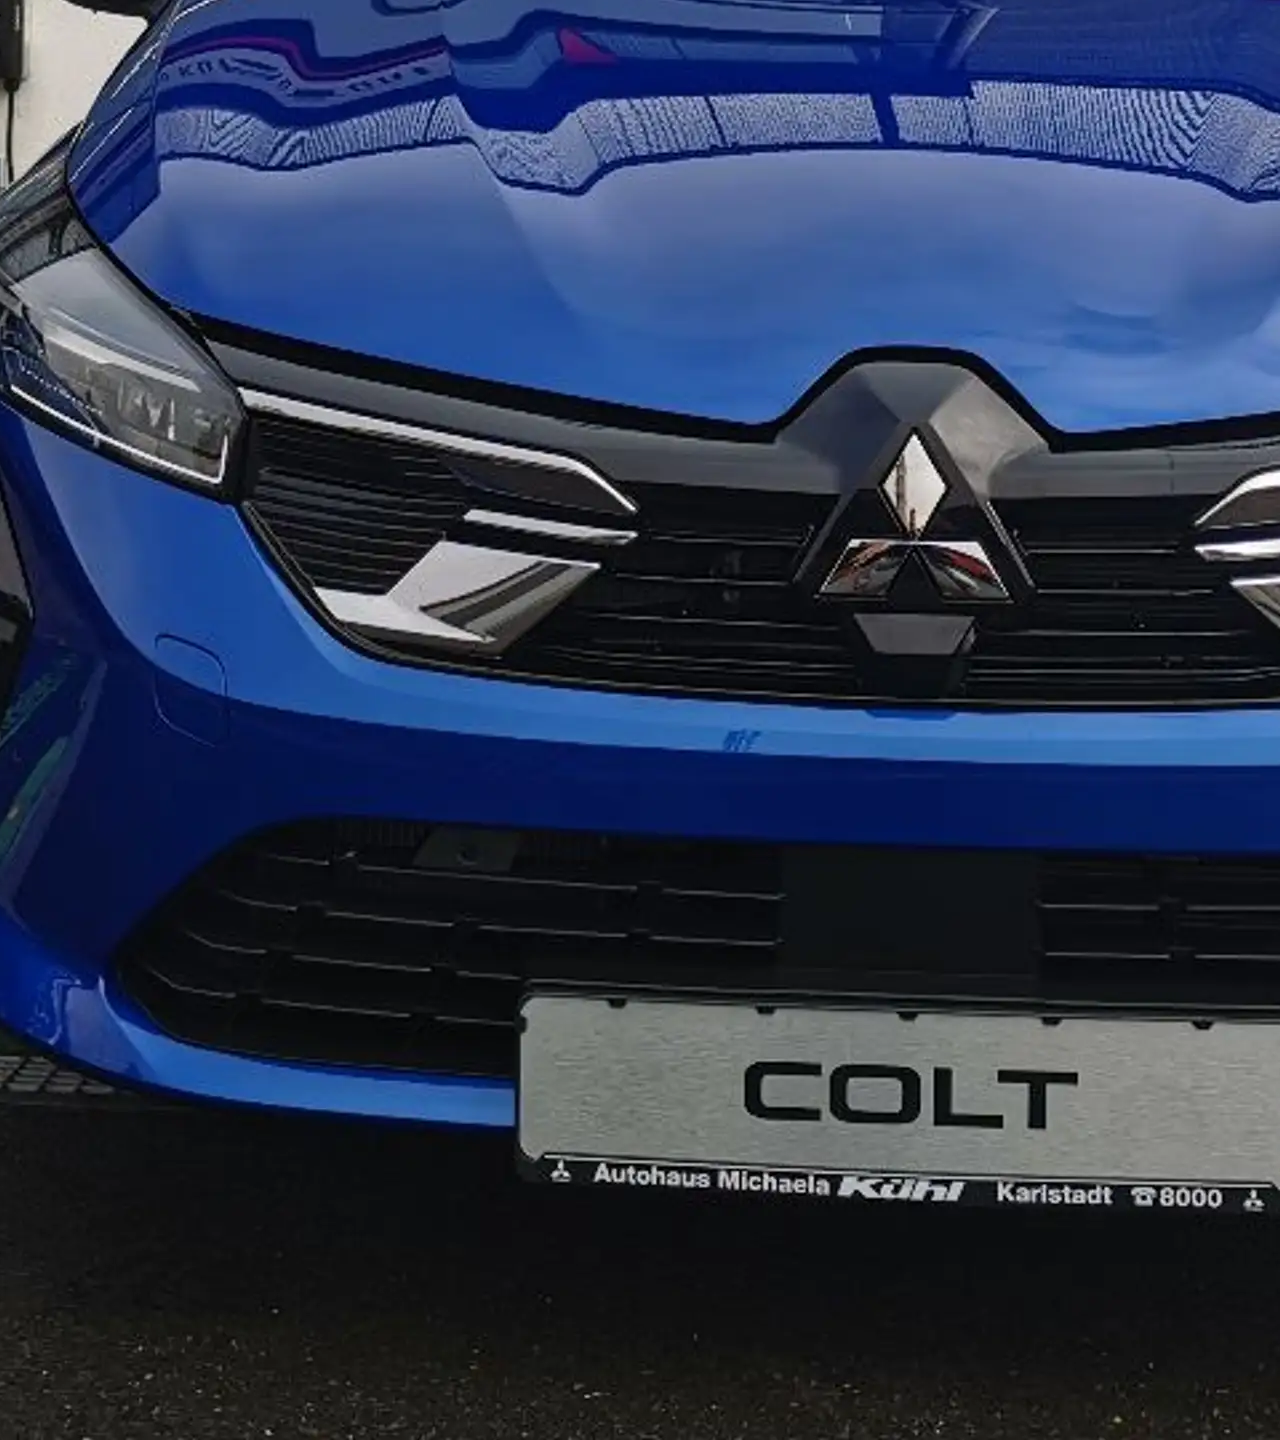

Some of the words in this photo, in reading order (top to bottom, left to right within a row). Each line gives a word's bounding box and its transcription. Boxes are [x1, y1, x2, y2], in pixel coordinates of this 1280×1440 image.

[743, 1061, 1078, 1130] COLT
[593, 1162, 711, 1189] Autohaus
[718, 1170, 831, 1197] Michaela
[837, 1175, 966, 1202] Kühl
[996, 1180, 1114, 1206] Karlstadt
[1159, 1188, 1223, 1209] 8000
